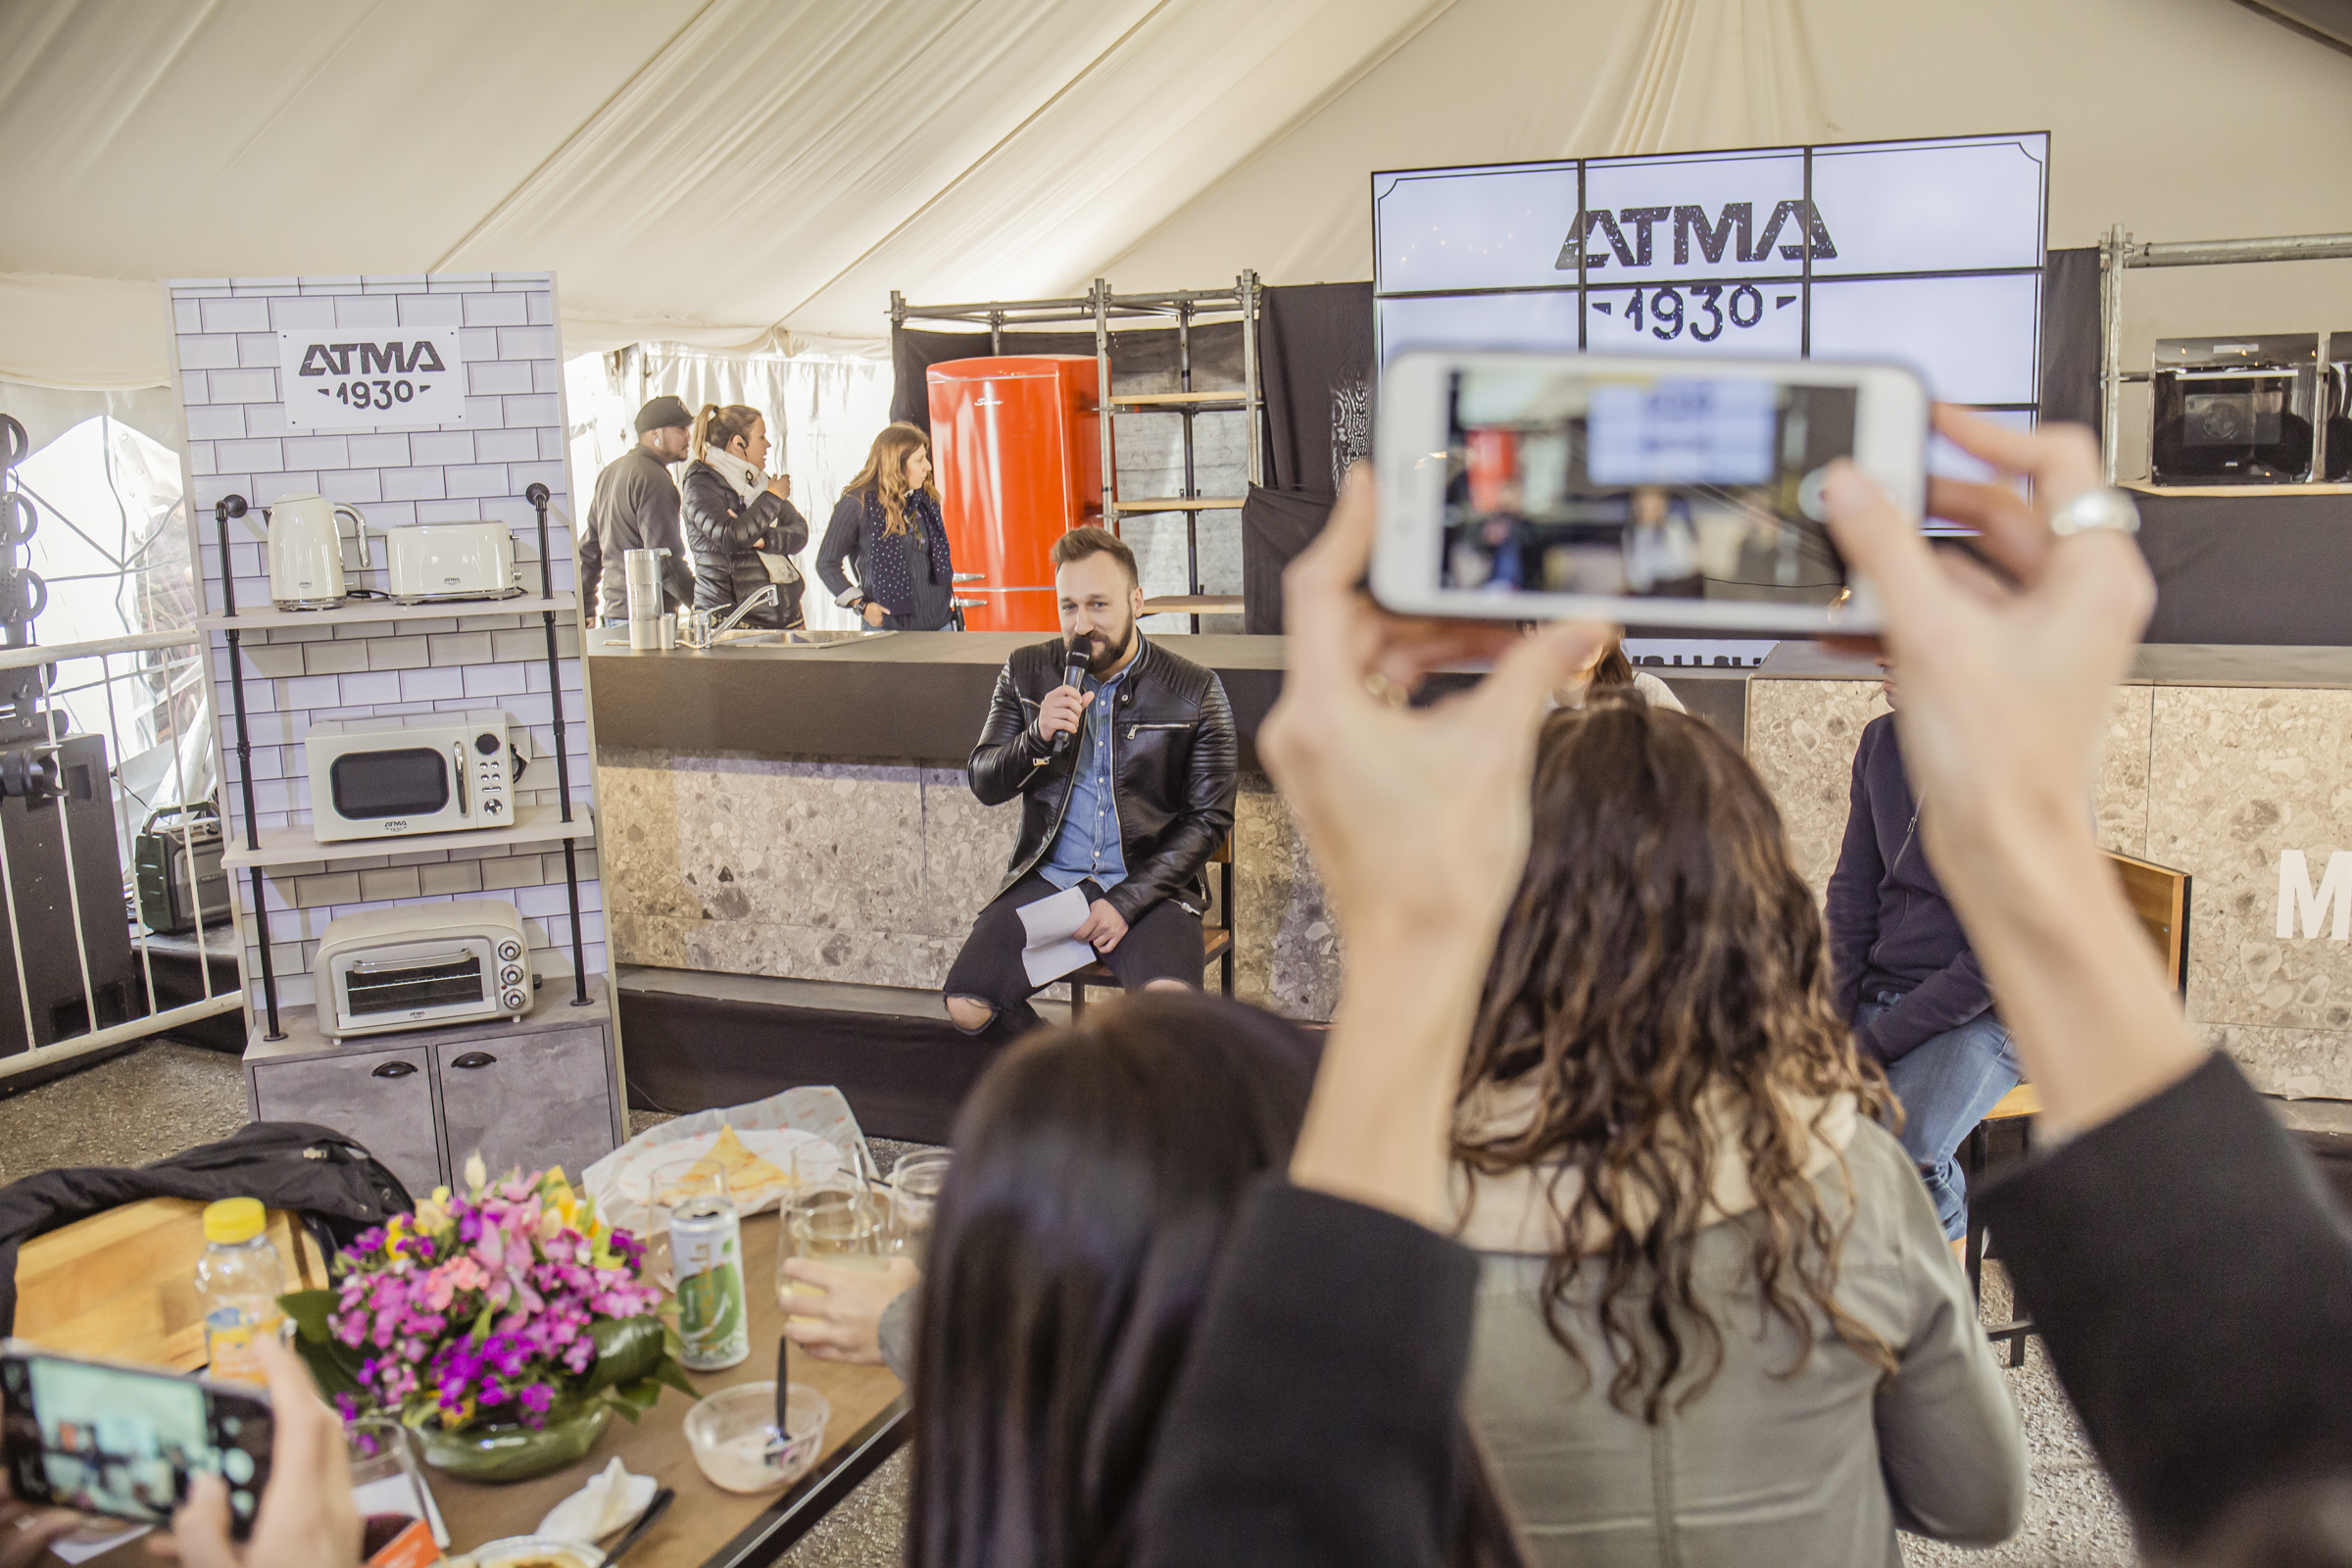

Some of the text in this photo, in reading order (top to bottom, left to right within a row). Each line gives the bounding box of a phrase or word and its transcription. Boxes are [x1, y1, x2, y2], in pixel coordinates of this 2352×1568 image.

[1554, 200, 1838, 270] ATMA
[1622, 284, 1765, 342] 1930
[298, 341, 446, 376] ATMA
[336, 379, 415, 410] 1930
[2276, 849, 2352, 941] M
